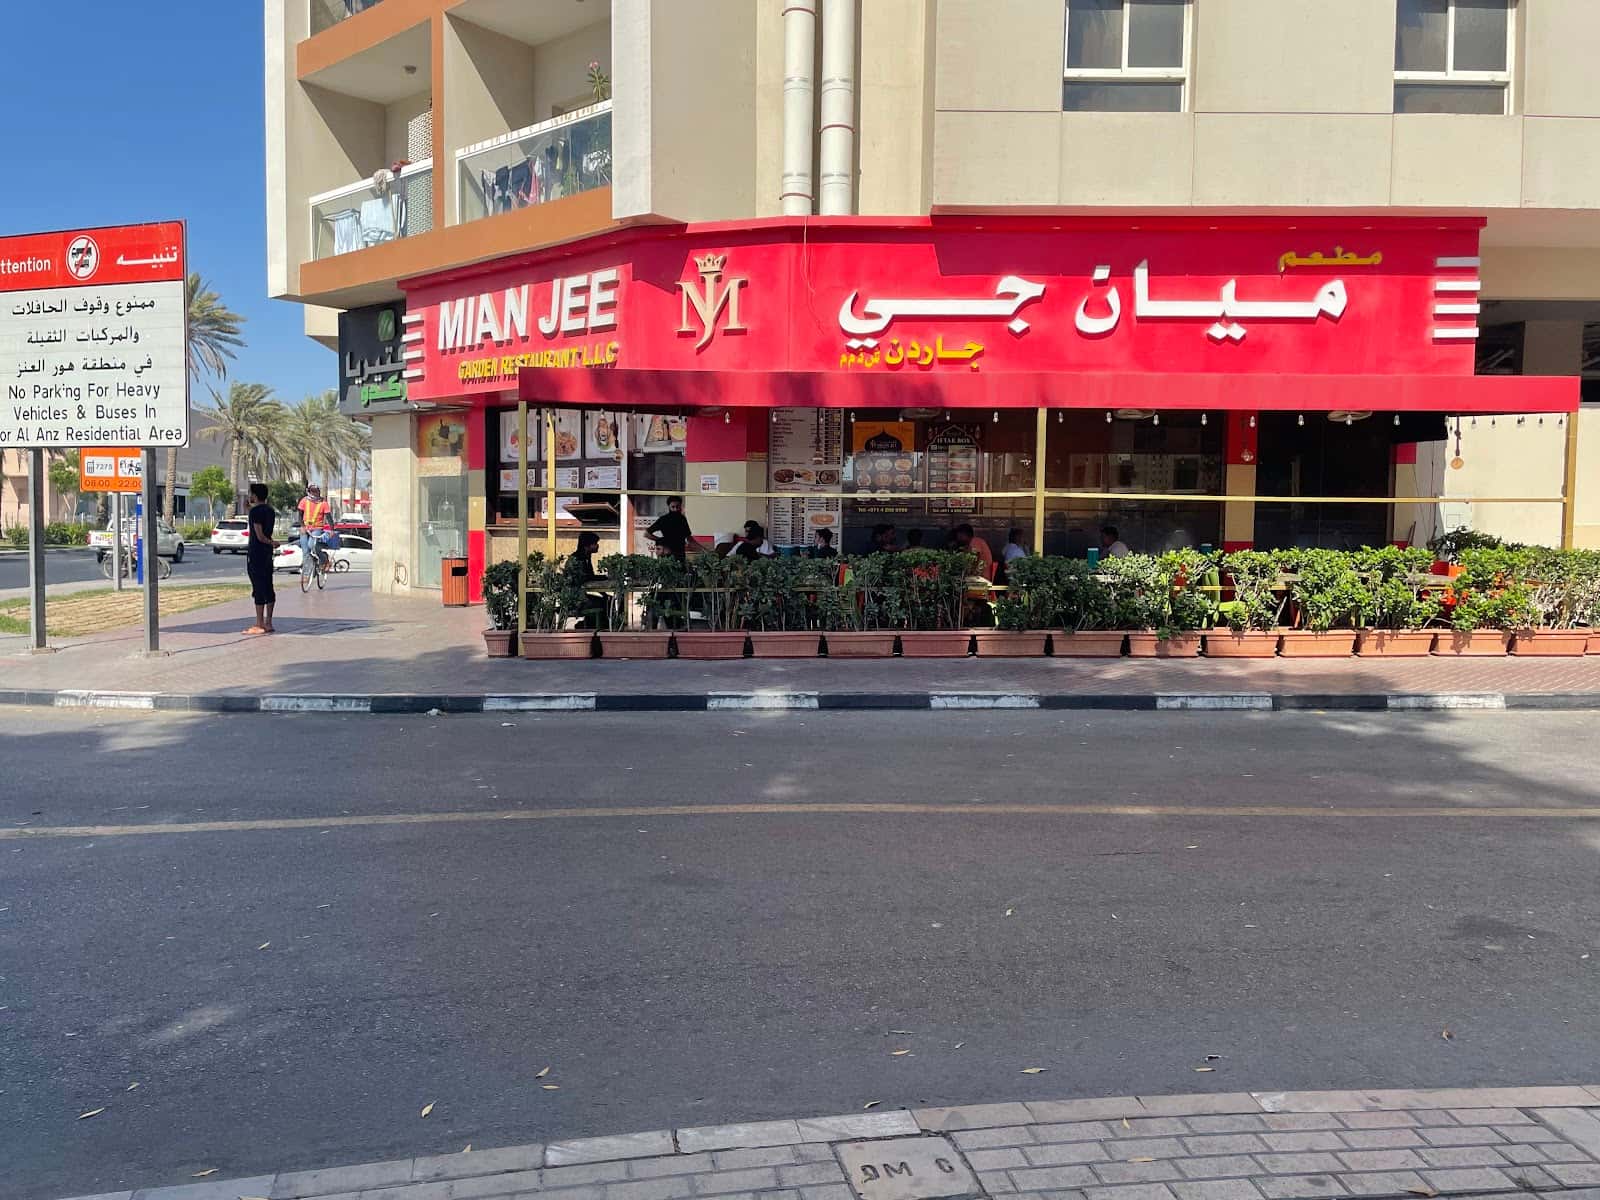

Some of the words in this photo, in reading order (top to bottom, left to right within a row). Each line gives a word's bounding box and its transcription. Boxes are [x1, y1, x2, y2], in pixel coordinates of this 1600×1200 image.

[0, 258, 51, 275] ttention
[116, 246, 178, 268] تنبيه
[1279, 246, 1382, 273] مطعم
[12, 299, 67, 316] الحافلات
[74, 296, 110, 315] وقوف
[115, 296, 156, 317] ممنوع
[438, 284, 529, 350] MIAN
[538, 269, 617, 334] JEE
[1074, 259, 1348, 340] ميان
[838, 275, 1046, 349] جي
[27, 328, 67, 347] الثقيلة
[76, 325, 140, 346] والمركبات
[885, 335, 984, 368] جاردن
[16, 358, 45, 378] العنز
[52, 360, 75, 377] هور
[82, 356, 127, 371] منطقة
[134, 354, 153, 378] في
[458, 356, 499, 379] GARDEN
[502, 346, 579, 374] RESTAURANT
[8, 385, 26, 400] No
[88, 382, 110, 397] For
[116, 382, 161, 400] Heavy
[13, 404, 68, 421] Vehicles
[76, 404, 87, 420] &
[96, 404, 137, 419] Buses
[145, 403, 157, 418] In
[0, 430, 12, 441] or
[16, 427, 30, 441] Al
[36, 427, 60, 441] Anz
[66, 425, 141, 441] Residential
[149, 425, 182, 440] Area
